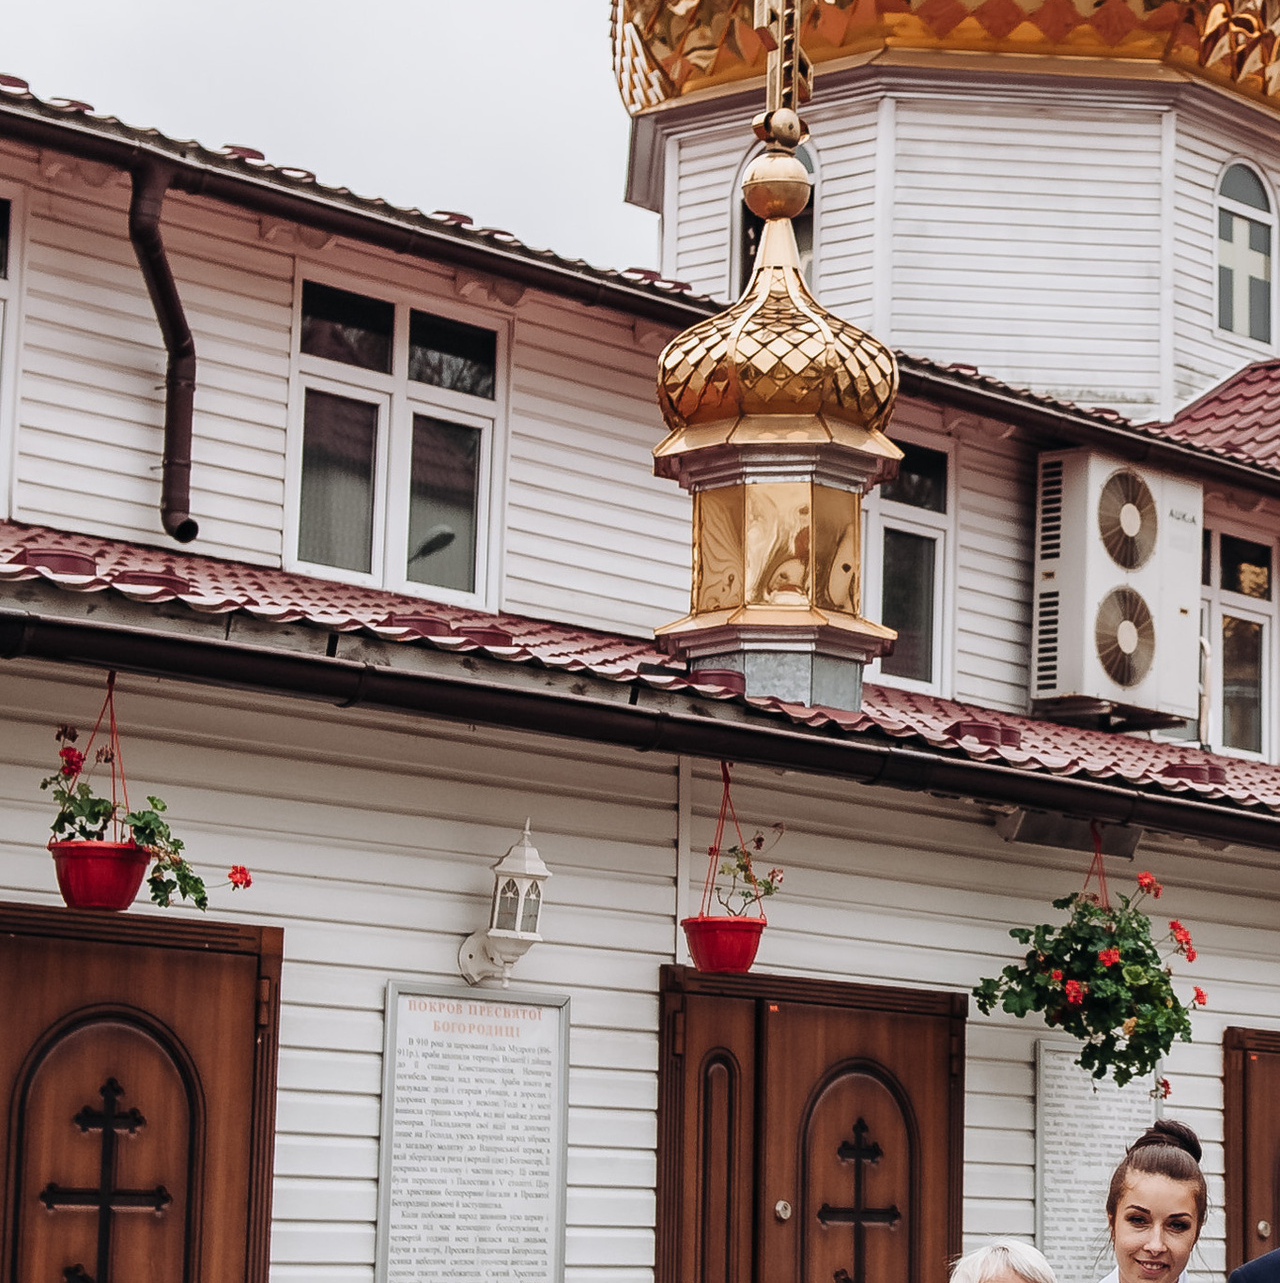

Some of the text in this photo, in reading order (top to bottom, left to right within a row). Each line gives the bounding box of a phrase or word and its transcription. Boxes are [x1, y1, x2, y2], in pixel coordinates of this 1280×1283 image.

[408, 1000, 543, 1021] ПОКРОВ ПРЕСВЯТОЇ
[433, 1020, 520, 1038] БОГОРОДИЦІ
